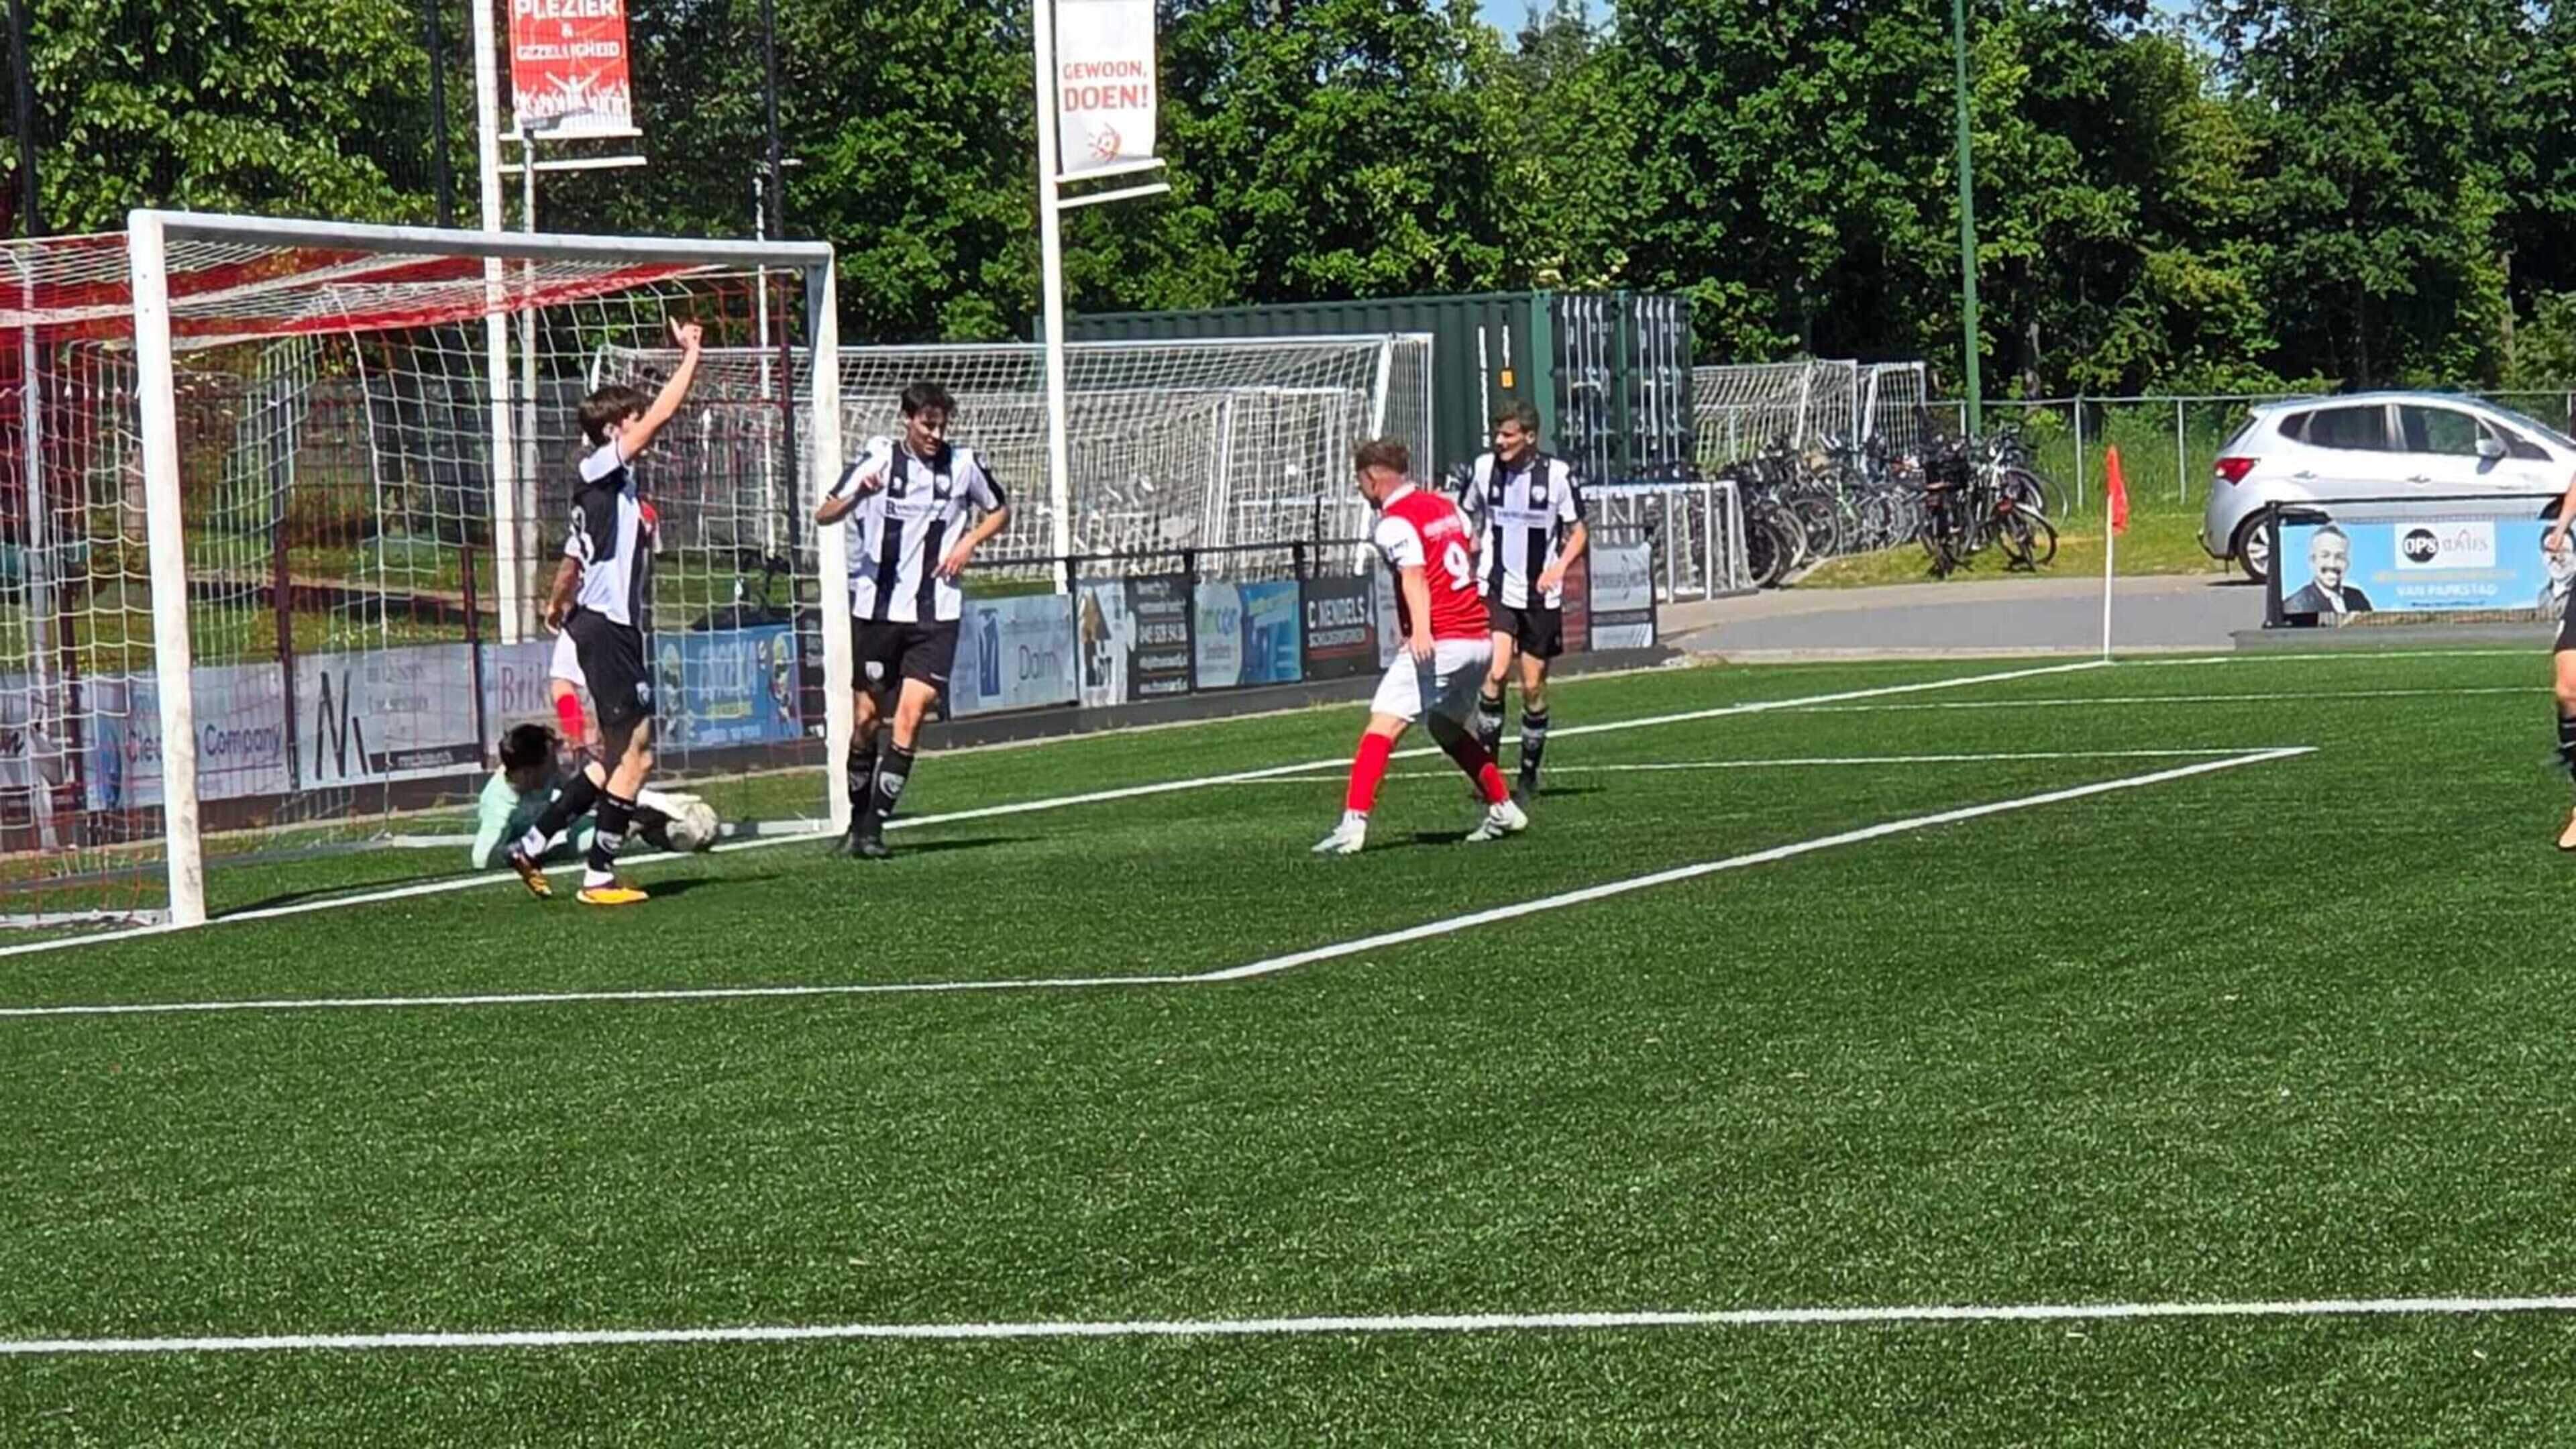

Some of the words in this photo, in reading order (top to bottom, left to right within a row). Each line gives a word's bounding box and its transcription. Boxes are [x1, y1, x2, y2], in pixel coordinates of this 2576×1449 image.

[513, 0, 619, 20] PLEZIER
[1063, 60, 1148, 80] GEWOON,
[1064, 85, 1149, 112] DOEN!
[1443, 541, 1470, 591] 9
[203, 720, 282, 762] Company
